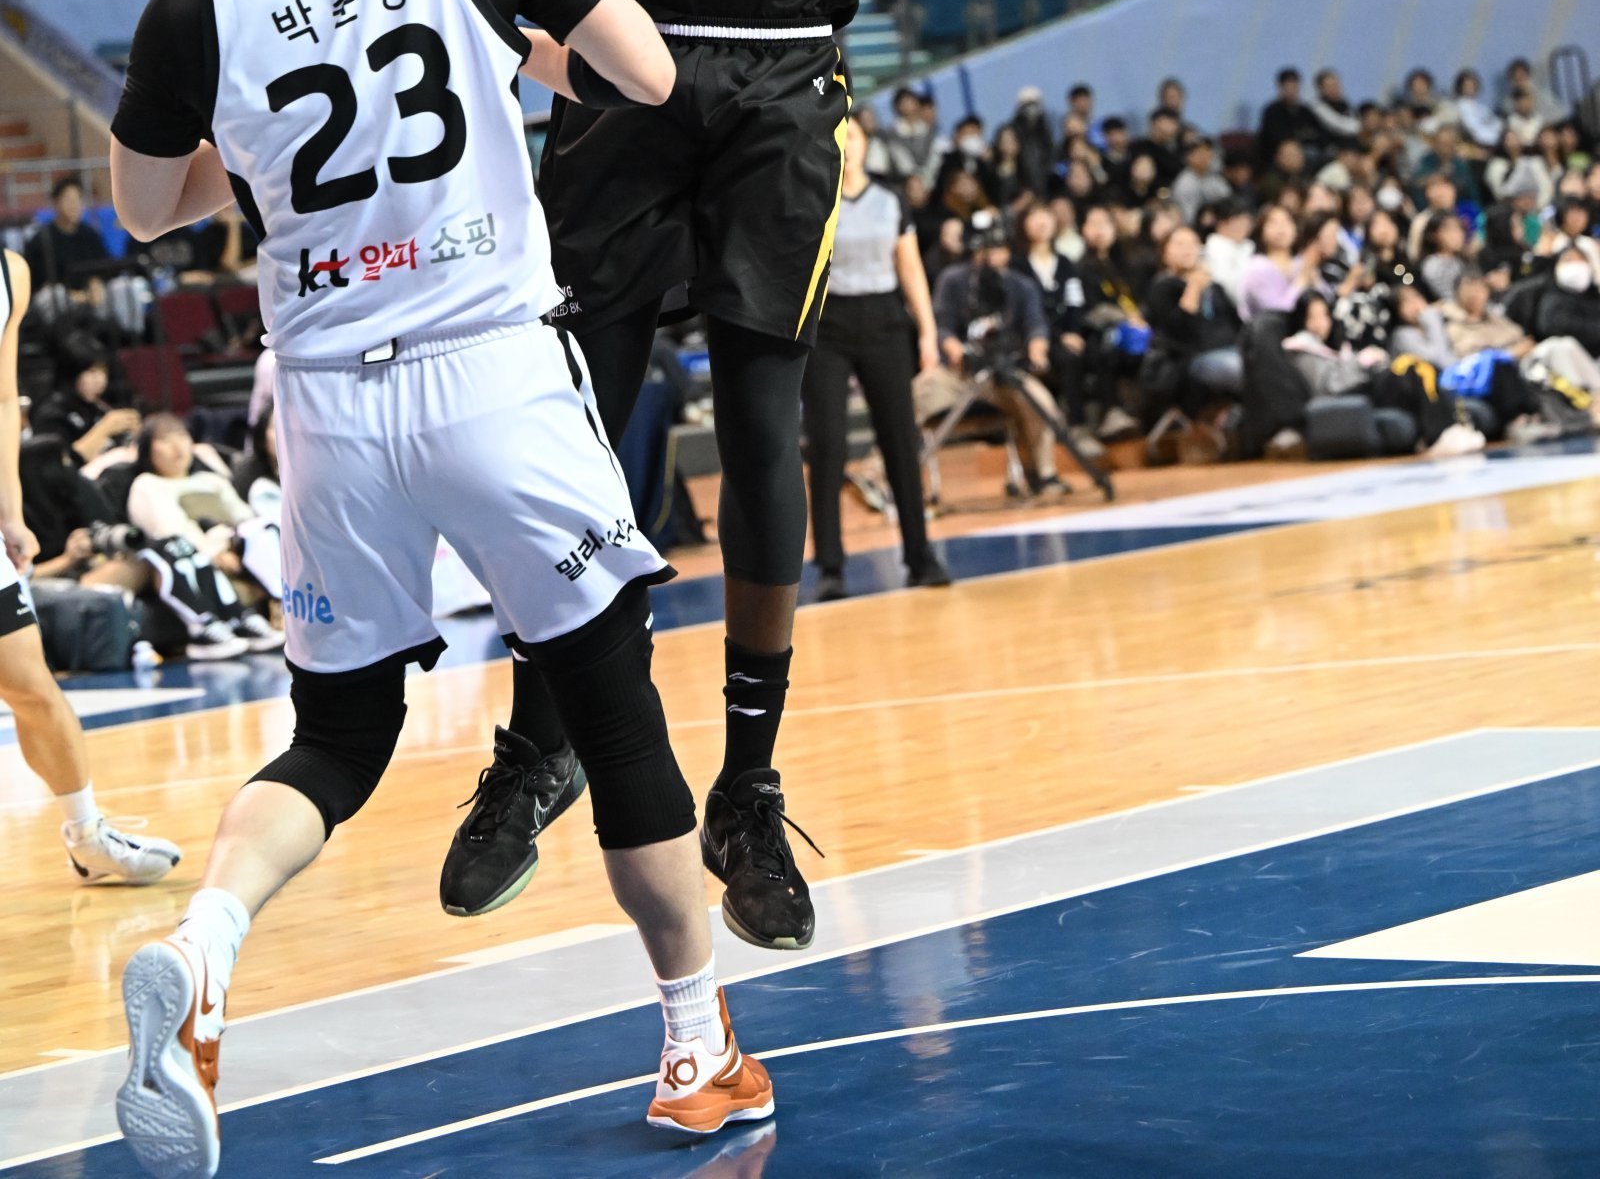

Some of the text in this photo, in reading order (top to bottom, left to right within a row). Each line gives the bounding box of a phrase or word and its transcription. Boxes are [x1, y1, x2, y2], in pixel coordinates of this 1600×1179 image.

[265, 23, 467, 215] 23
[298, 248, 350, 297] kt
[430, 213, 497, 264] 쇼핑
